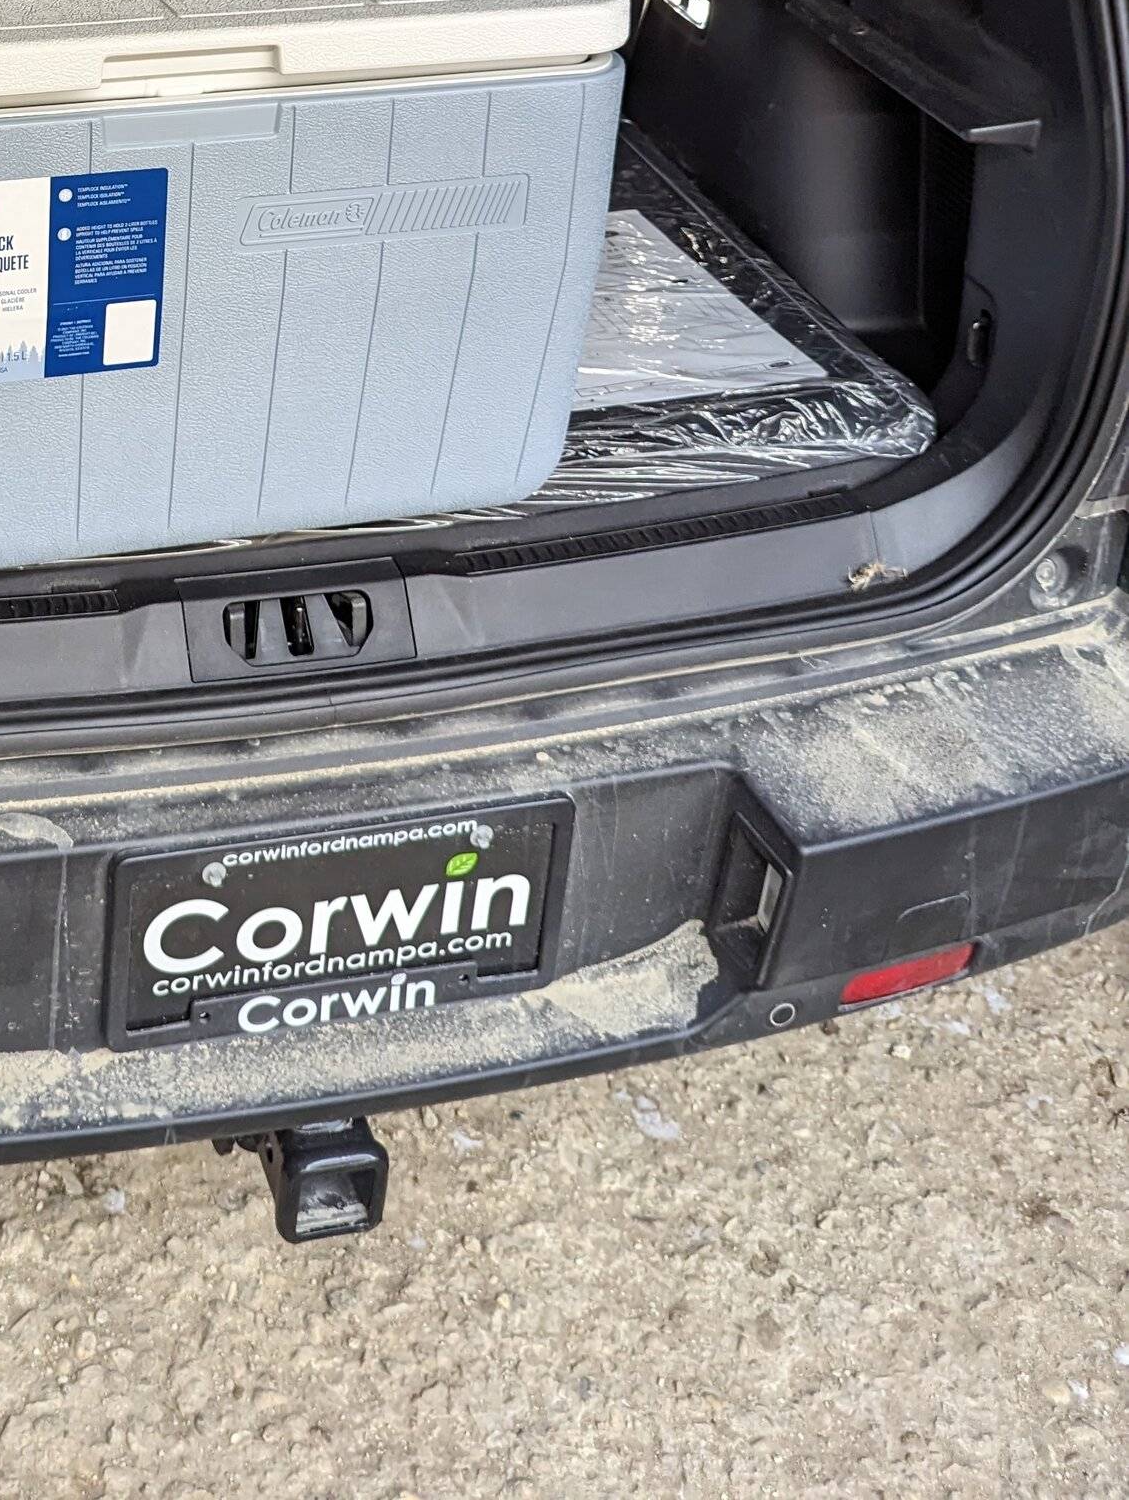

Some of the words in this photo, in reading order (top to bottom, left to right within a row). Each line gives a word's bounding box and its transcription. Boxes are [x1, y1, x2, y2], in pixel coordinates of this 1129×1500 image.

[257, 206, 341, 232] Coleman
[22, 351, 27, 360] L
[222, 818, 478, 868] corwinfordnampa.com
[142, 852, 532, 974] Corwin
[152, 929, 513, 998] corwinfordnampa.com
[237, 972, 437, 1034] Corwin
